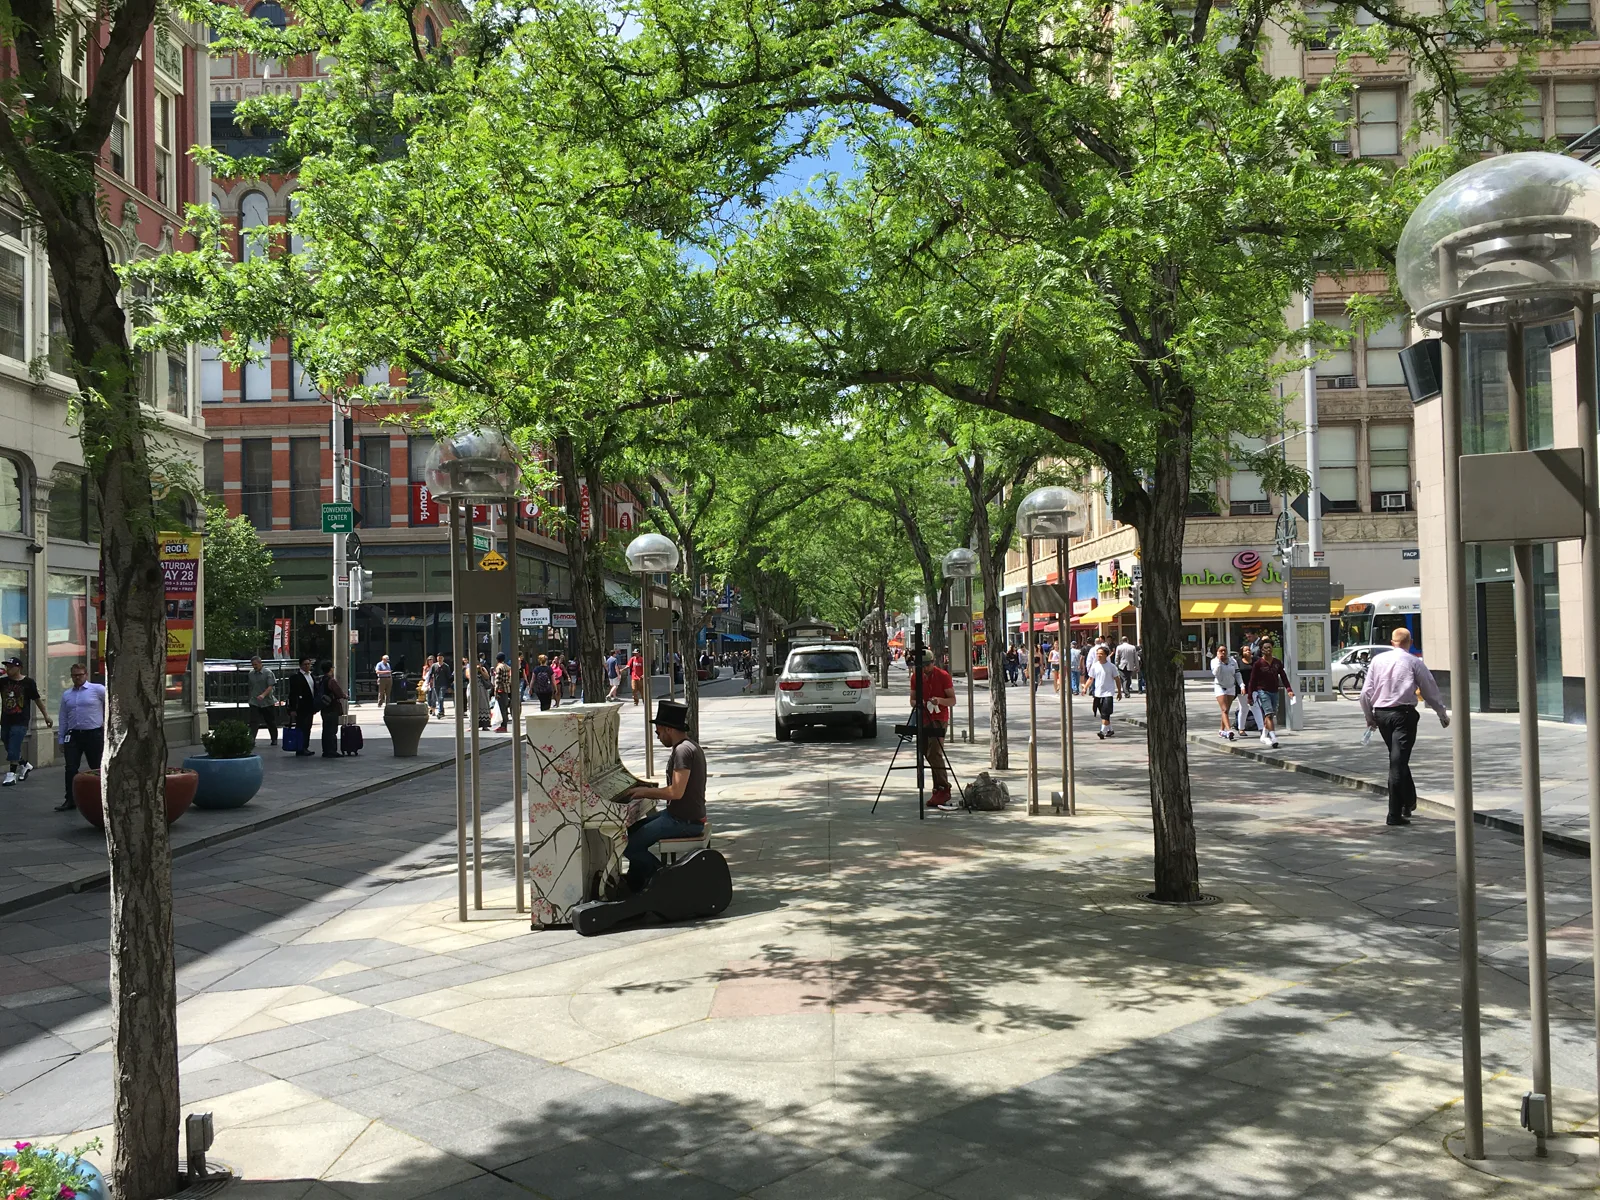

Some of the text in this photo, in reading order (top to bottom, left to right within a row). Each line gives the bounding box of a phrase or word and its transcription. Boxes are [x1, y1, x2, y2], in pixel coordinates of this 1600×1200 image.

[165, 544, 189, 553] ROCK
[160, 562, 196, 570] ATURDAY
[164, 570, 194, 581] AY 28
[1292, 567, 1329, 576] California
[1181, 568, 1236, 585] mba
